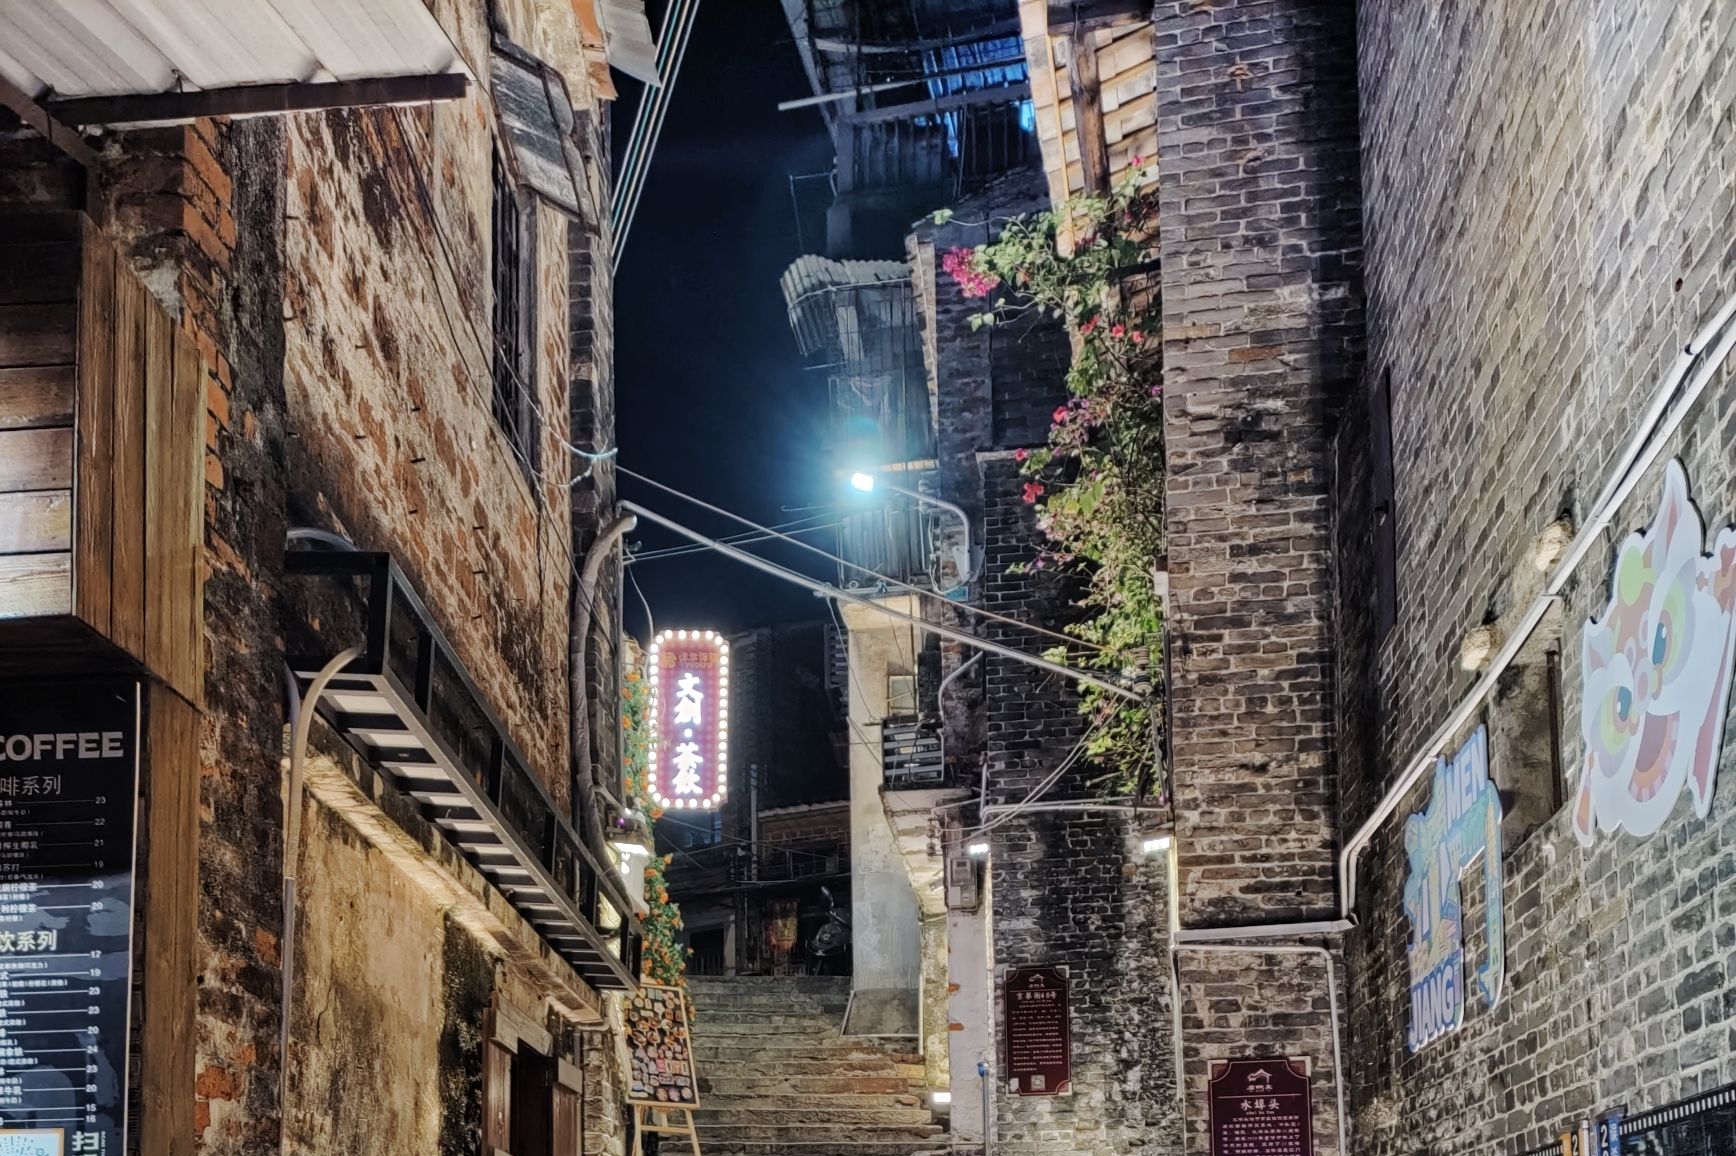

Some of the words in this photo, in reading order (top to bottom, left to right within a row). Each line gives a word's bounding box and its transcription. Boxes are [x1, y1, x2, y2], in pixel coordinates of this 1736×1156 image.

[0, 731, 124, 761] OFFEE
[1446, 729, 1487, 830] MEN
[95, 796, 107, 805] 23
[94, 818, 106, 826] 22
[94, 839, 104, 847] 21
[94, 860, 104, 869] 19
[92, 880, 104, 889] 20
[91, 901, 103, 911] 20
[90, 950, 102, 959] 17
[89, 968, 101, 977] 19
[88, 986, 101, 996] 23
[87, 1005, 100, 1015] 23
[1409, 964, 1454, 1047] JIANG
[87, 1026, 99, 1035] 20
[86, 1064, 98, 1073] 23
[85, 1084, 97, 1093] 20
[85, 1103, 97, 1112] 15
[1240, 1098, 1280, 1111] 水埠头
[85, 1115, 96, 1123] 16
